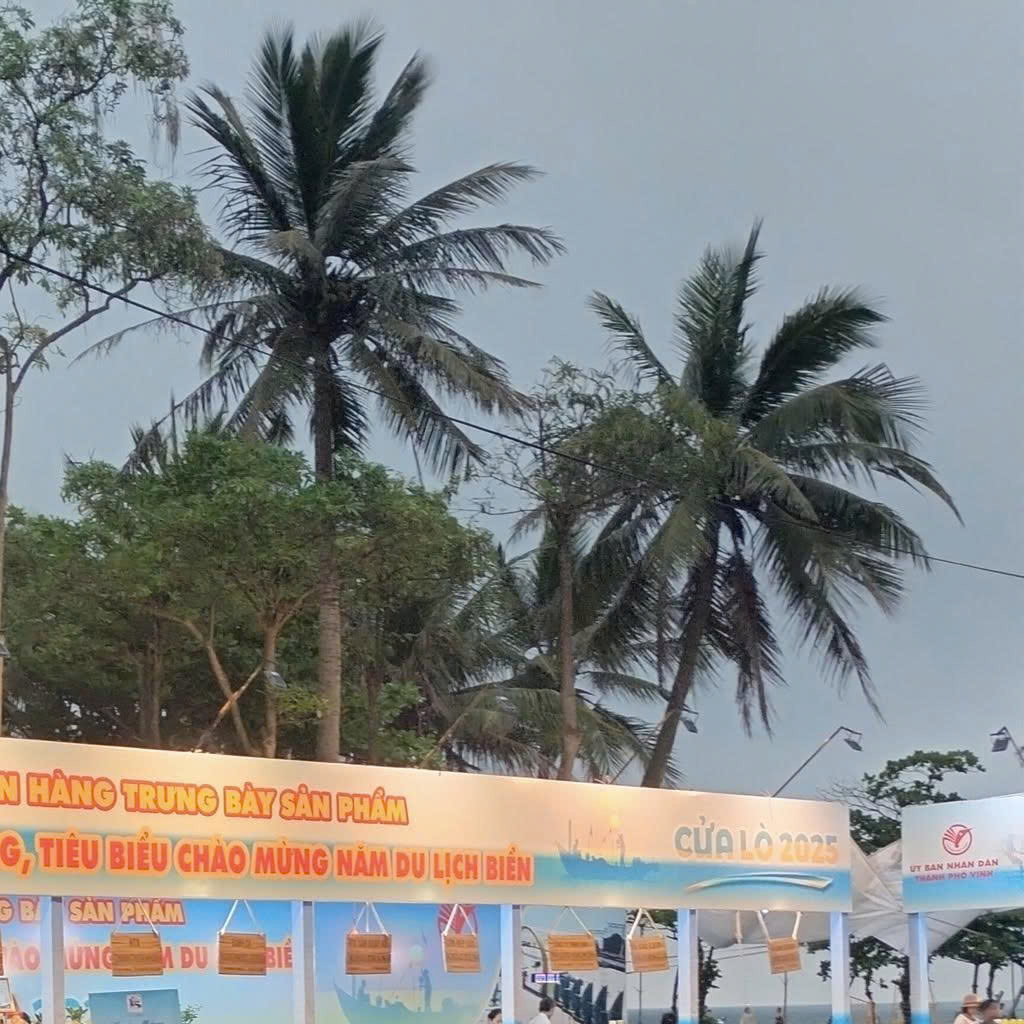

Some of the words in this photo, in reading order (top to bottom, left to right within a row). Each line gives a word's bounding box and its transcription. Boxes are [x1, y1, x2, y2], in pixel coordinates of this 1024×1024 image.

[27, 769, 117, 810] HÀNG
[121, 779, 218, 816] TRƯNG
[224, 782, 276, 819] BÀY
[280, 784, 331, 821] SẢN
[337, 787, 409, 825] PHẨM
[40, 833, 99, 870] TIÊU
[109, 831, 168, 871] BIỂU
[178, 839, 247, 873] CHÀO
[255, 841, 328, 875] MỪNG
[336, 846, 389, 877] NĂM
[396, 852, 425, 878] DU
[434, 853, 478, 885] LỊCH
[486, 847, 531, 881] BIỂN
[675, 815, 733, 859] CỬA
[739, 823, 773, 861] LÒ
[779, 832, 839, 864] 2025
[181, 946, 208, 968] DU
